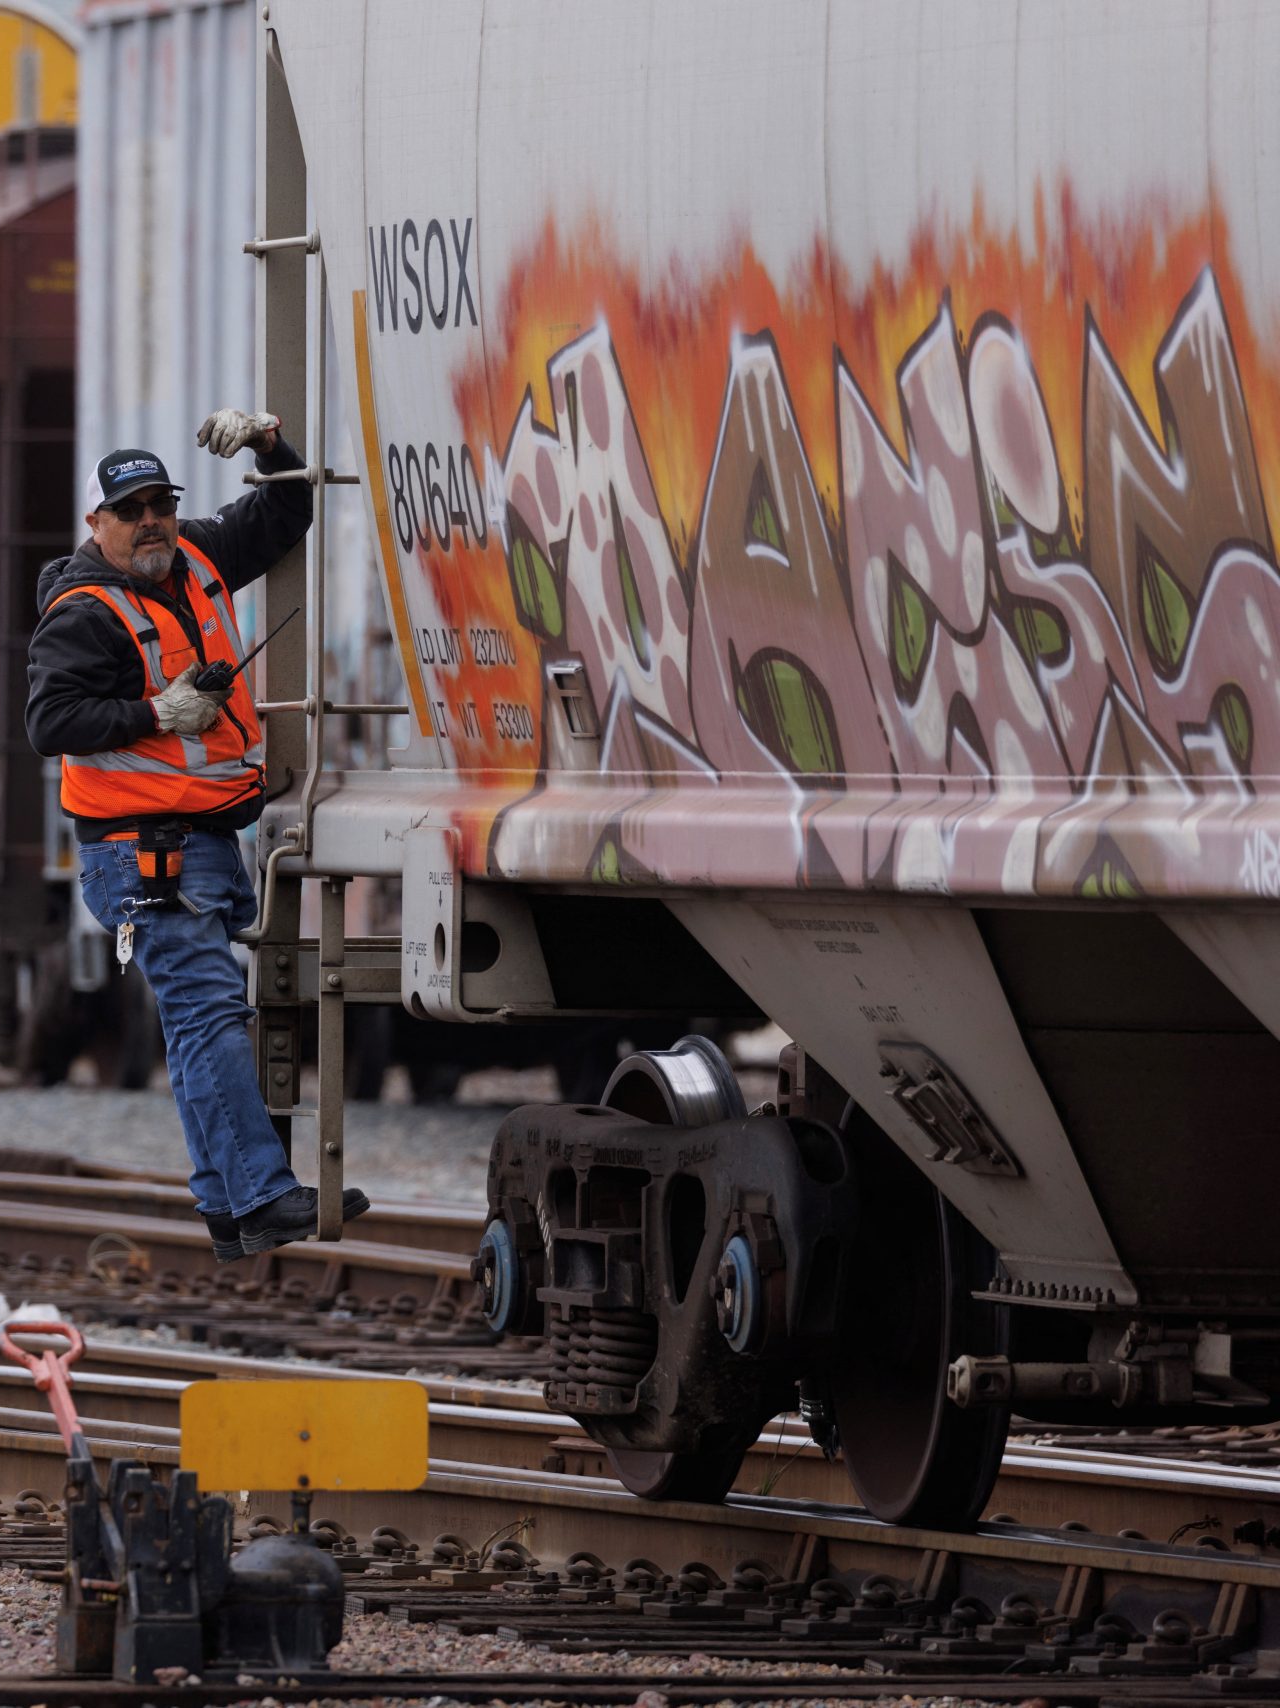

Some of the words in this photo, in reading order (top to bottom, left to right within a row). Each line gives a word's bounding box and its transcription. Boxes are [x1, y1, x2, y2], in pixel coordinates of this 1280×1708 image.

[368, 218, 478, 334] WSOX
[416, 628, 435, 664] LD
[434, 628, 464, 665] LMT
[432, 701, 449, 738] LT
[457, 702, 482, 738] WT
[492, 702, 534, 740] 53300
